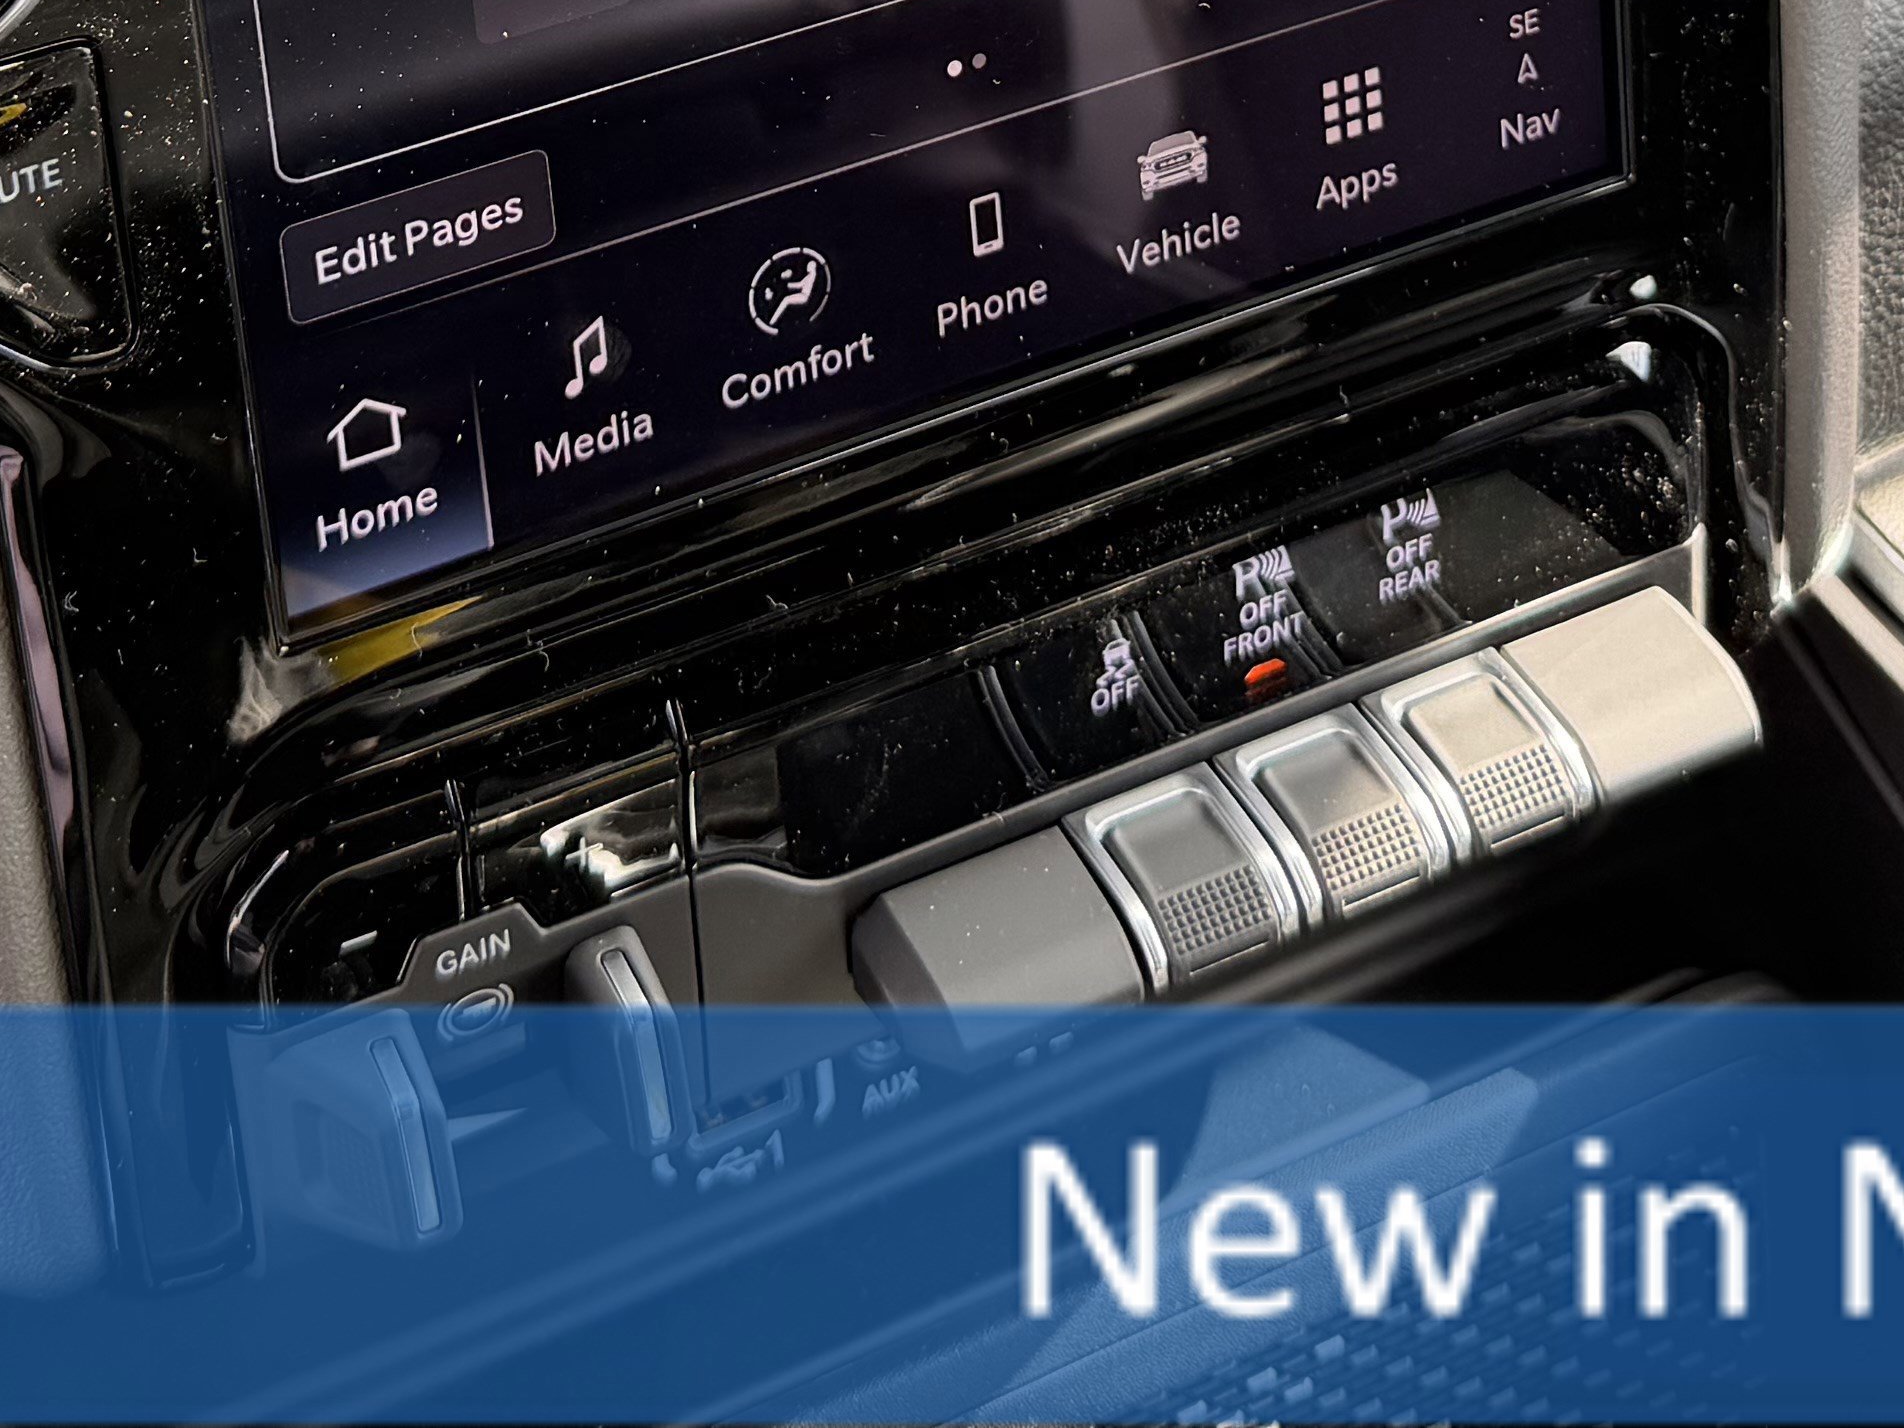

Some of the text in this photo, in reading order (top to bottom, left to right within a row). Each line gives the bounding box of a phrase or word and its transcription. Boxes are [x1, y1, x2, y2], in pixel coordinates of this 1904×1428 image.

[1508, 8, 1540, 39] SE
[1501, 108, 1560, 148] Nav
[1316, 161, 1398, 210] Apps
[315, 195, 523, 284] Edit Pages
[1117, 212, 1240, 273] Vehicle
[937, 278, 1048, 336] Phone
[721, 332, 874, 409] Comfort
[534, 409, 654, 476] Media
[317, 485, 438, 552] Home
[1386, 533, 1433, 572] OFF
[1379, 559, 1440, 605] REAR
[1240, 589, 1287, 631] OFF
[1224, 610, 1307, 666] FRONT
[1091, 677, 1138, 717] OFF
[435, 928, 511, 976] GAIN
[862, 1066, 920, 1116] AUX
